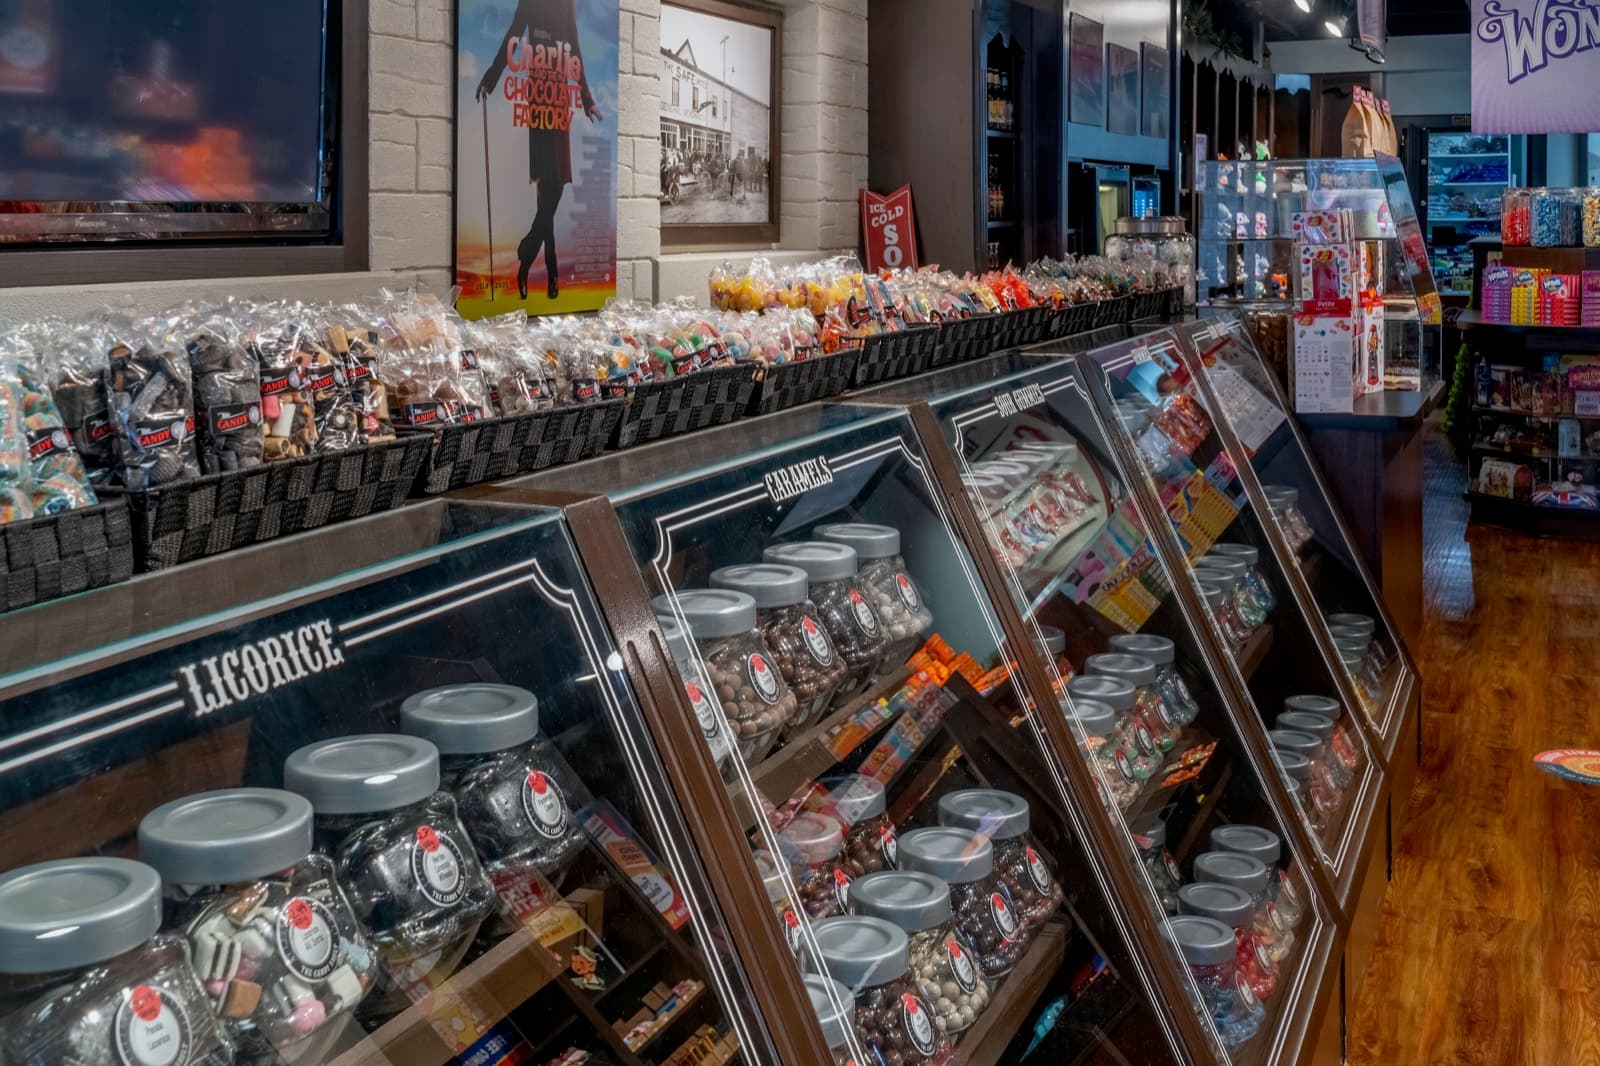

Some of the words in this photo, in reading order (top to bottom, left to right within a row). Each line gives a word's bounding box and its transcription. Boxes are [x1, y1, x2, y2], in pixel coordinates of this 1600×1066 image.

[507, 36, 582, 82] Charlie
[504, 76, 583, 109] CHOCOLATE
[513, 103, 574, 131] FACTORY
[869, 204, 886, 214] ICE
[872, 205, 904, 228] COLD
[217, 414, 249, 430] CANDY
[136, 430, 170, 446] CANDY
[765, 455, 833, 502] CARAMELS
[179, 618, 345, 716] LICORICE
